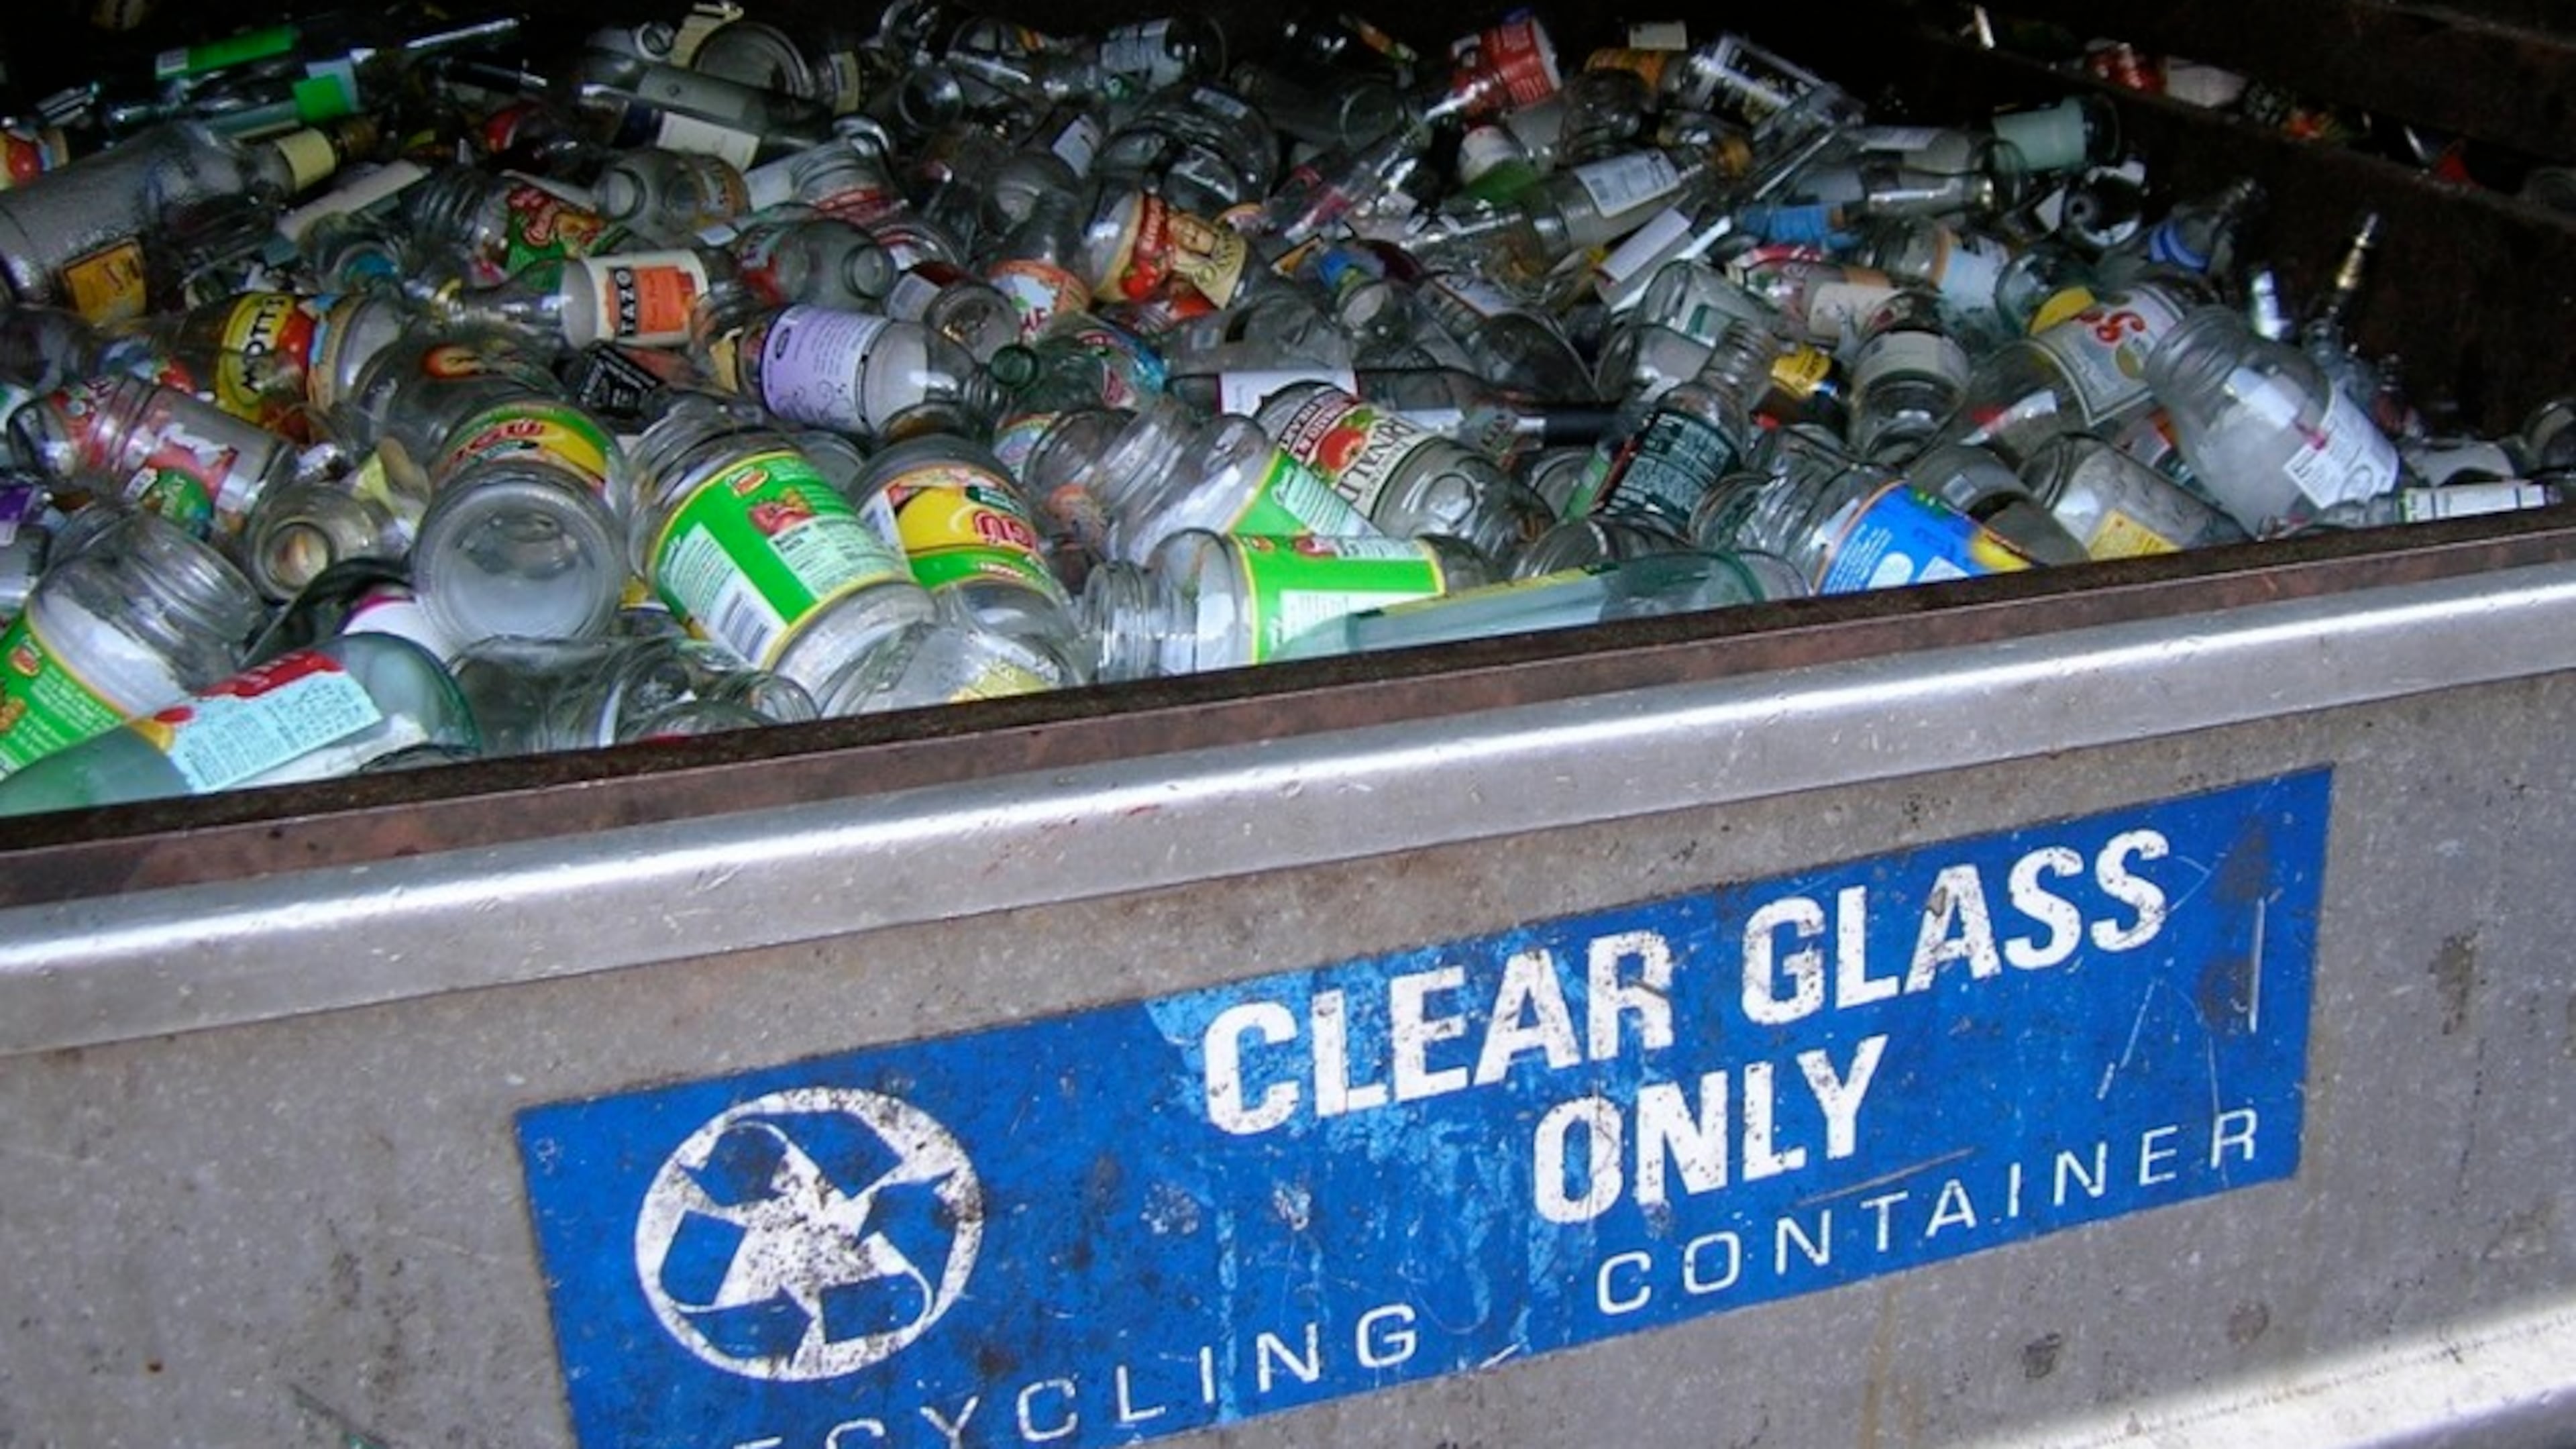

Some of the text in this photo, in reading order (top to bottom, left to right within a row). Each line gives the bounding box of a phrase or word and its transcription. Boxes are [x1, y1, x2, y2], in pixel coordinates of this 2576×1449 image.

[614, 270, 635, 333] TAZO
[1203, 829, 2169, 1135] CLEAR GLASS
[1533, 1034, 1888, 1224] ONLY
[1595, 1109, 2258, 1315] CONTAINER
